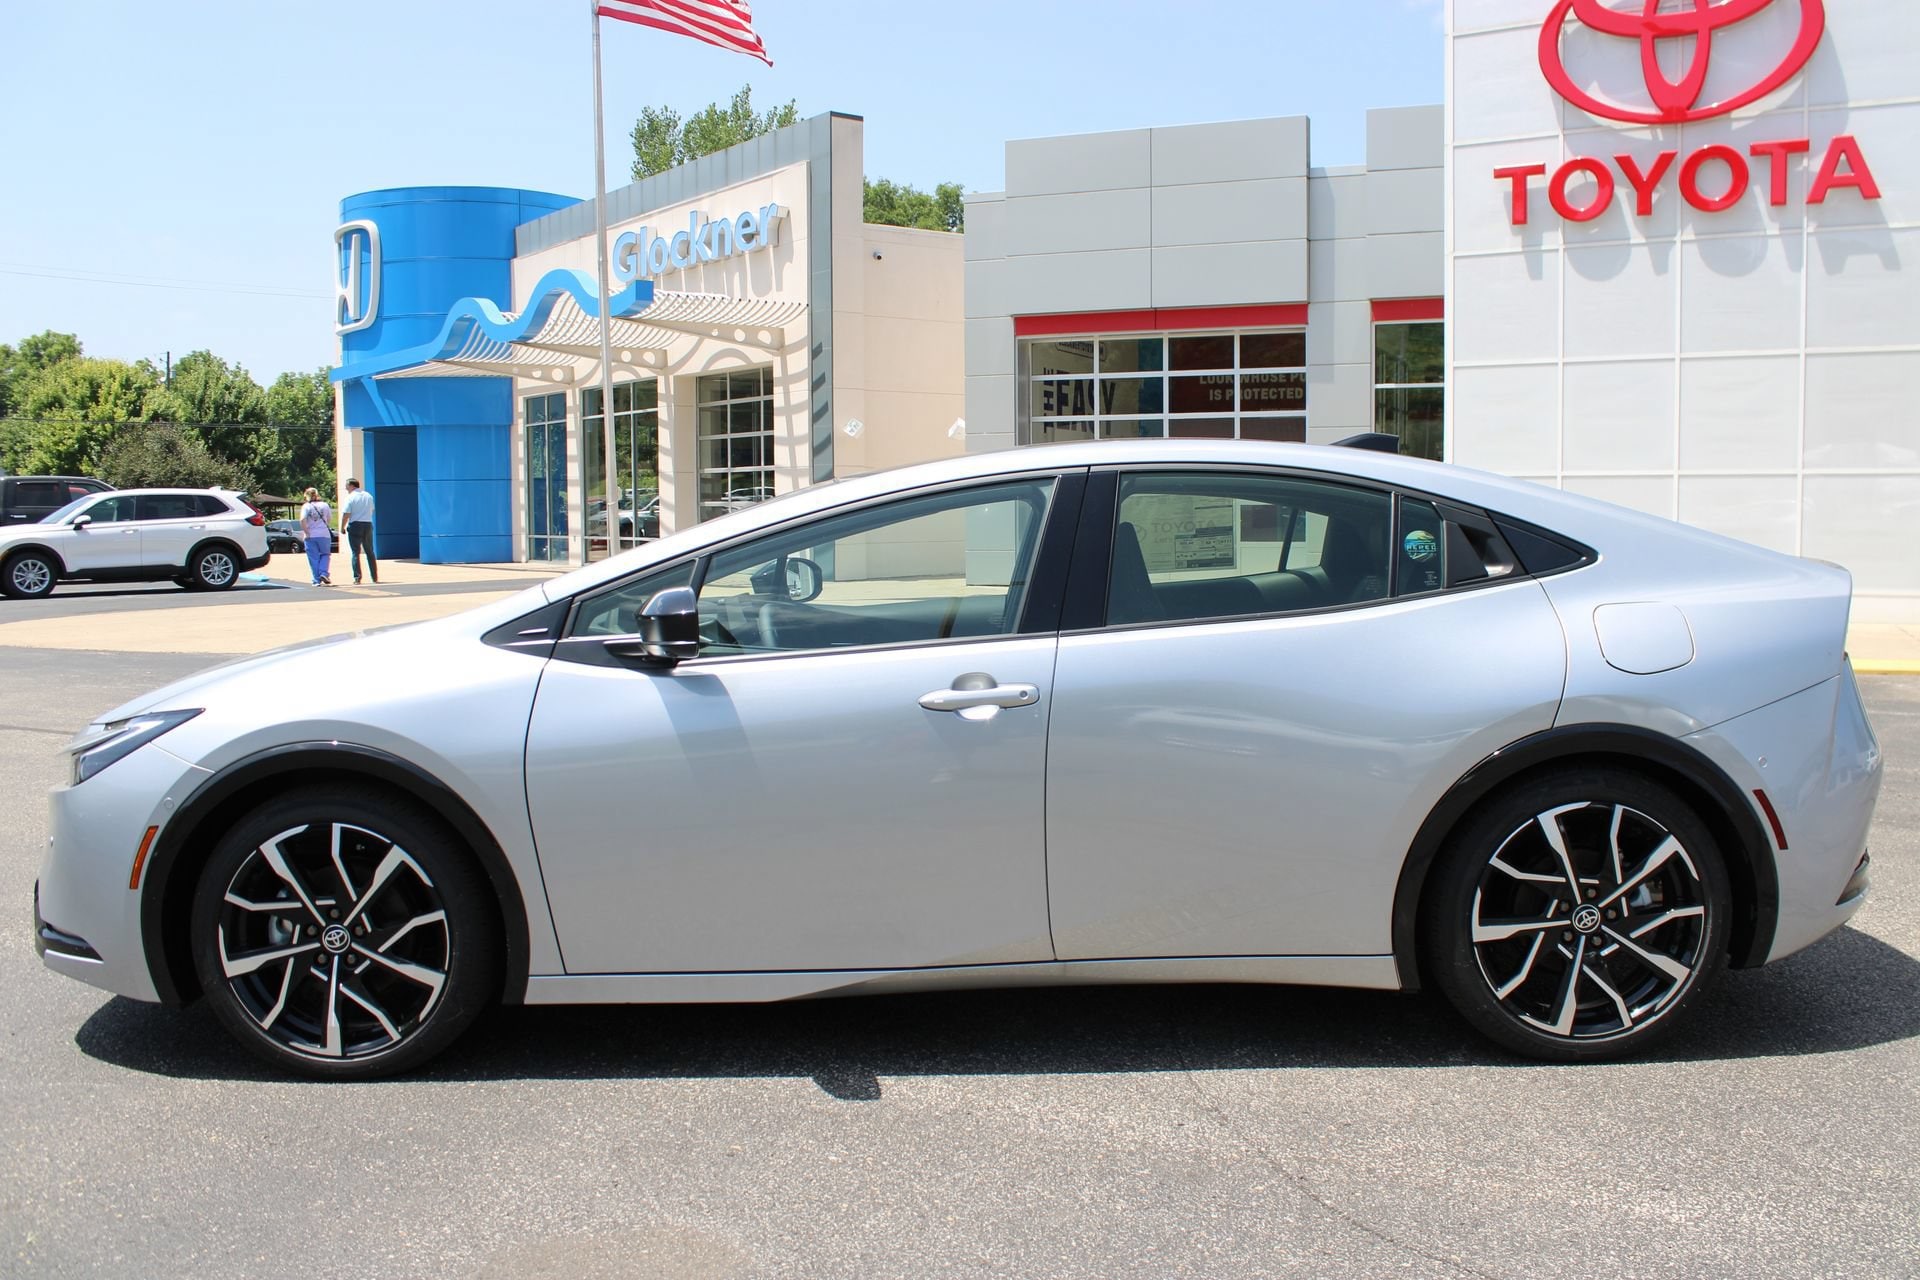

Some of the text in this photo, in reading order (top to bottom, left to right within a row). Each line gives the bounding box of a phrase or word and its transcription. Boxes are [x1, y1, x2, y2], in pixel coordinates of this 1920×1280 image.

[1493, 135, 1882, 226] TOYOTA
[612, 202, 786, 284] Glockner
[1209, 388, 1304, 400] IS POTECTED
